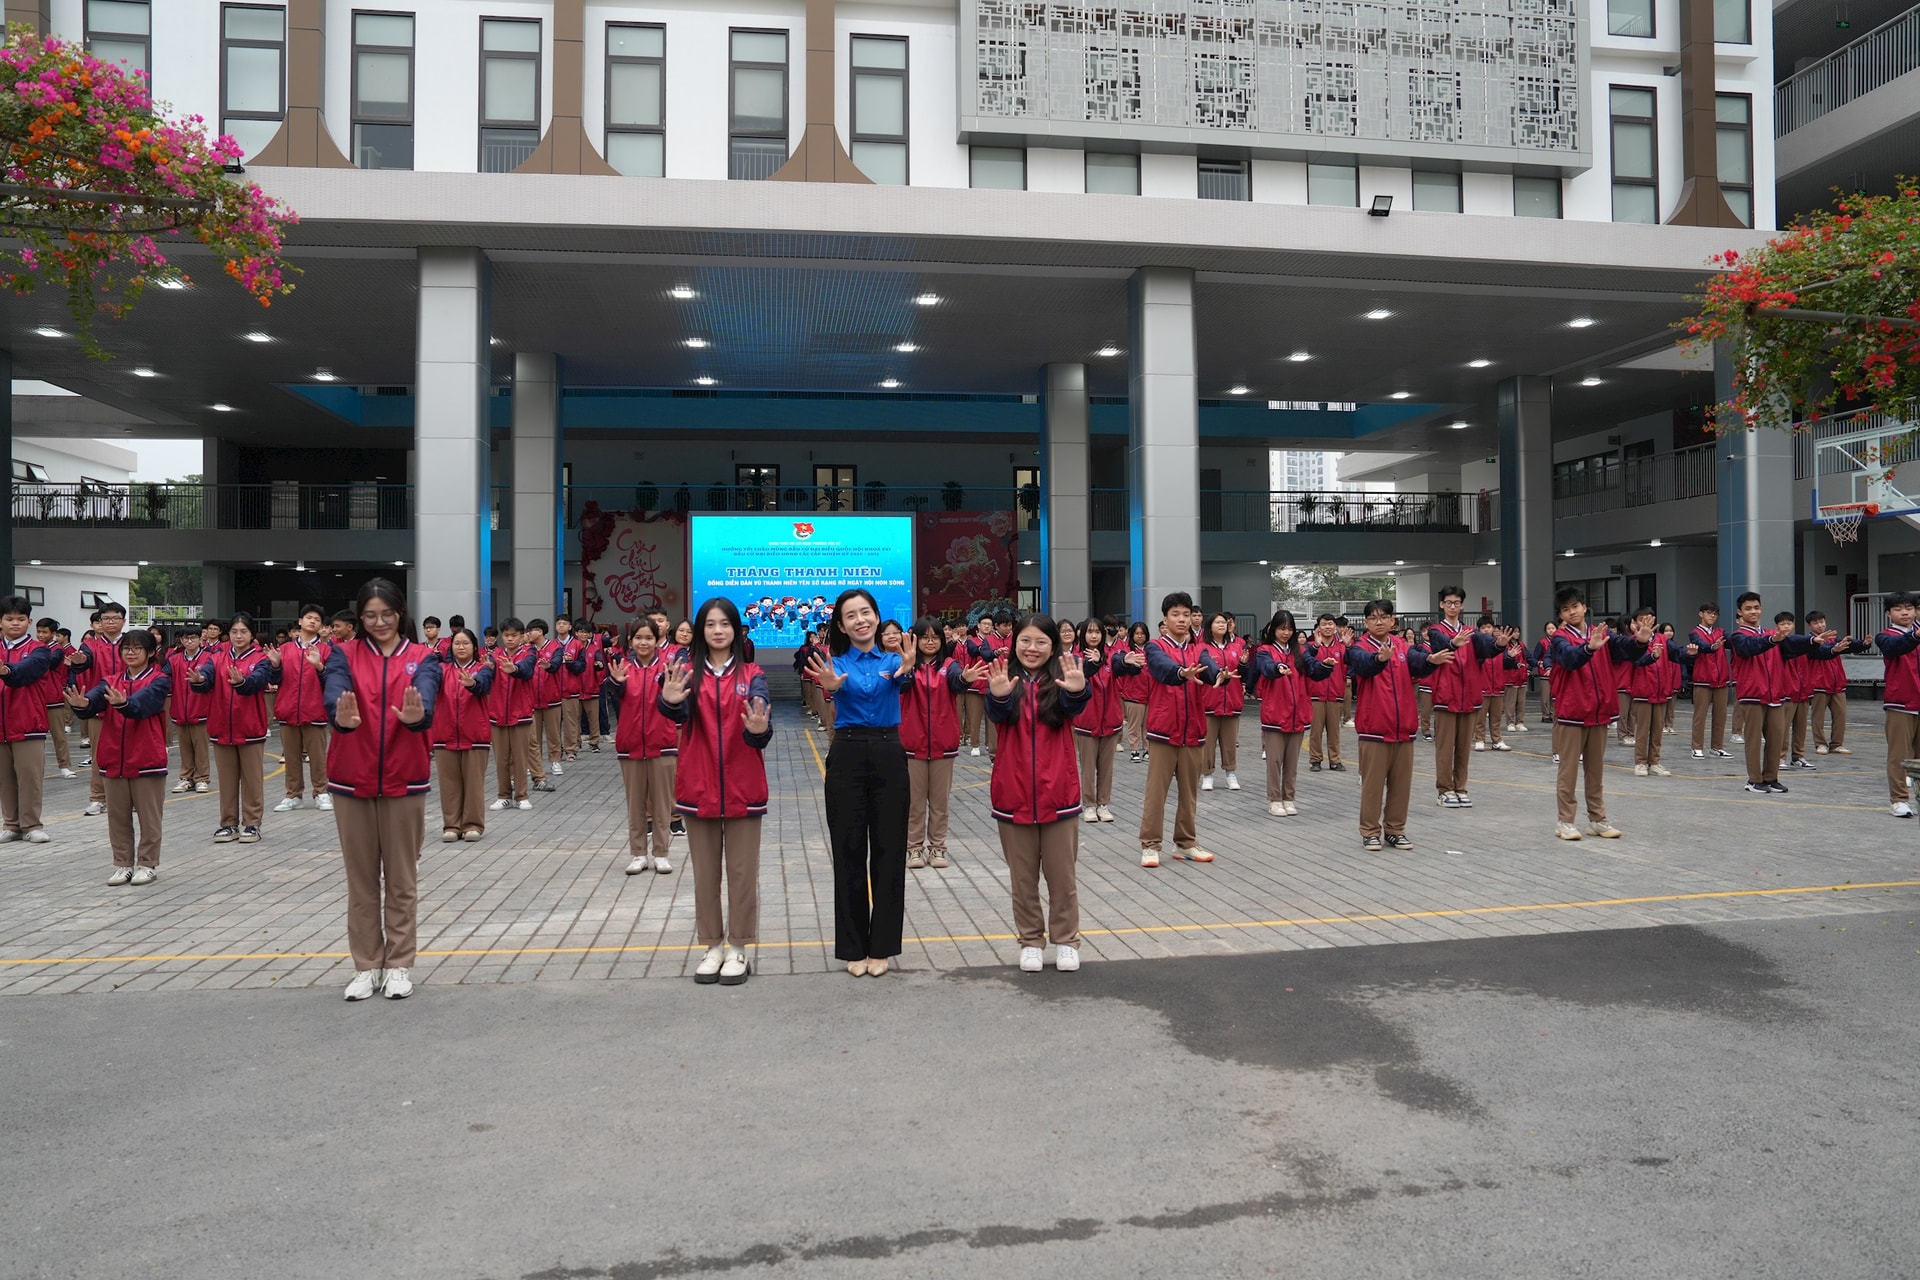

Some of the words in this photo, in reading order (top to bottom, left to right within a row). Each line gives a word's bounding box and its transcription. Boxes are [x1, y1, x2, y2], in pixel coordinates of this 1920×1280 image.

[726, 566, 780, 577] THÁNG
[784, 567, 839, 577] THANH
[842, 566, 882, 577] NIÊN
[707, 578, 724, 586] ĐỒNG
[725, 578, 740, 586] DIỄN
[740, 578, 753, 586] DÂN
[782, 578, 798, 586] NIÊN
[798, 578, 810, 586] YÊN
[889, 578, 905, 586] SÔNG
